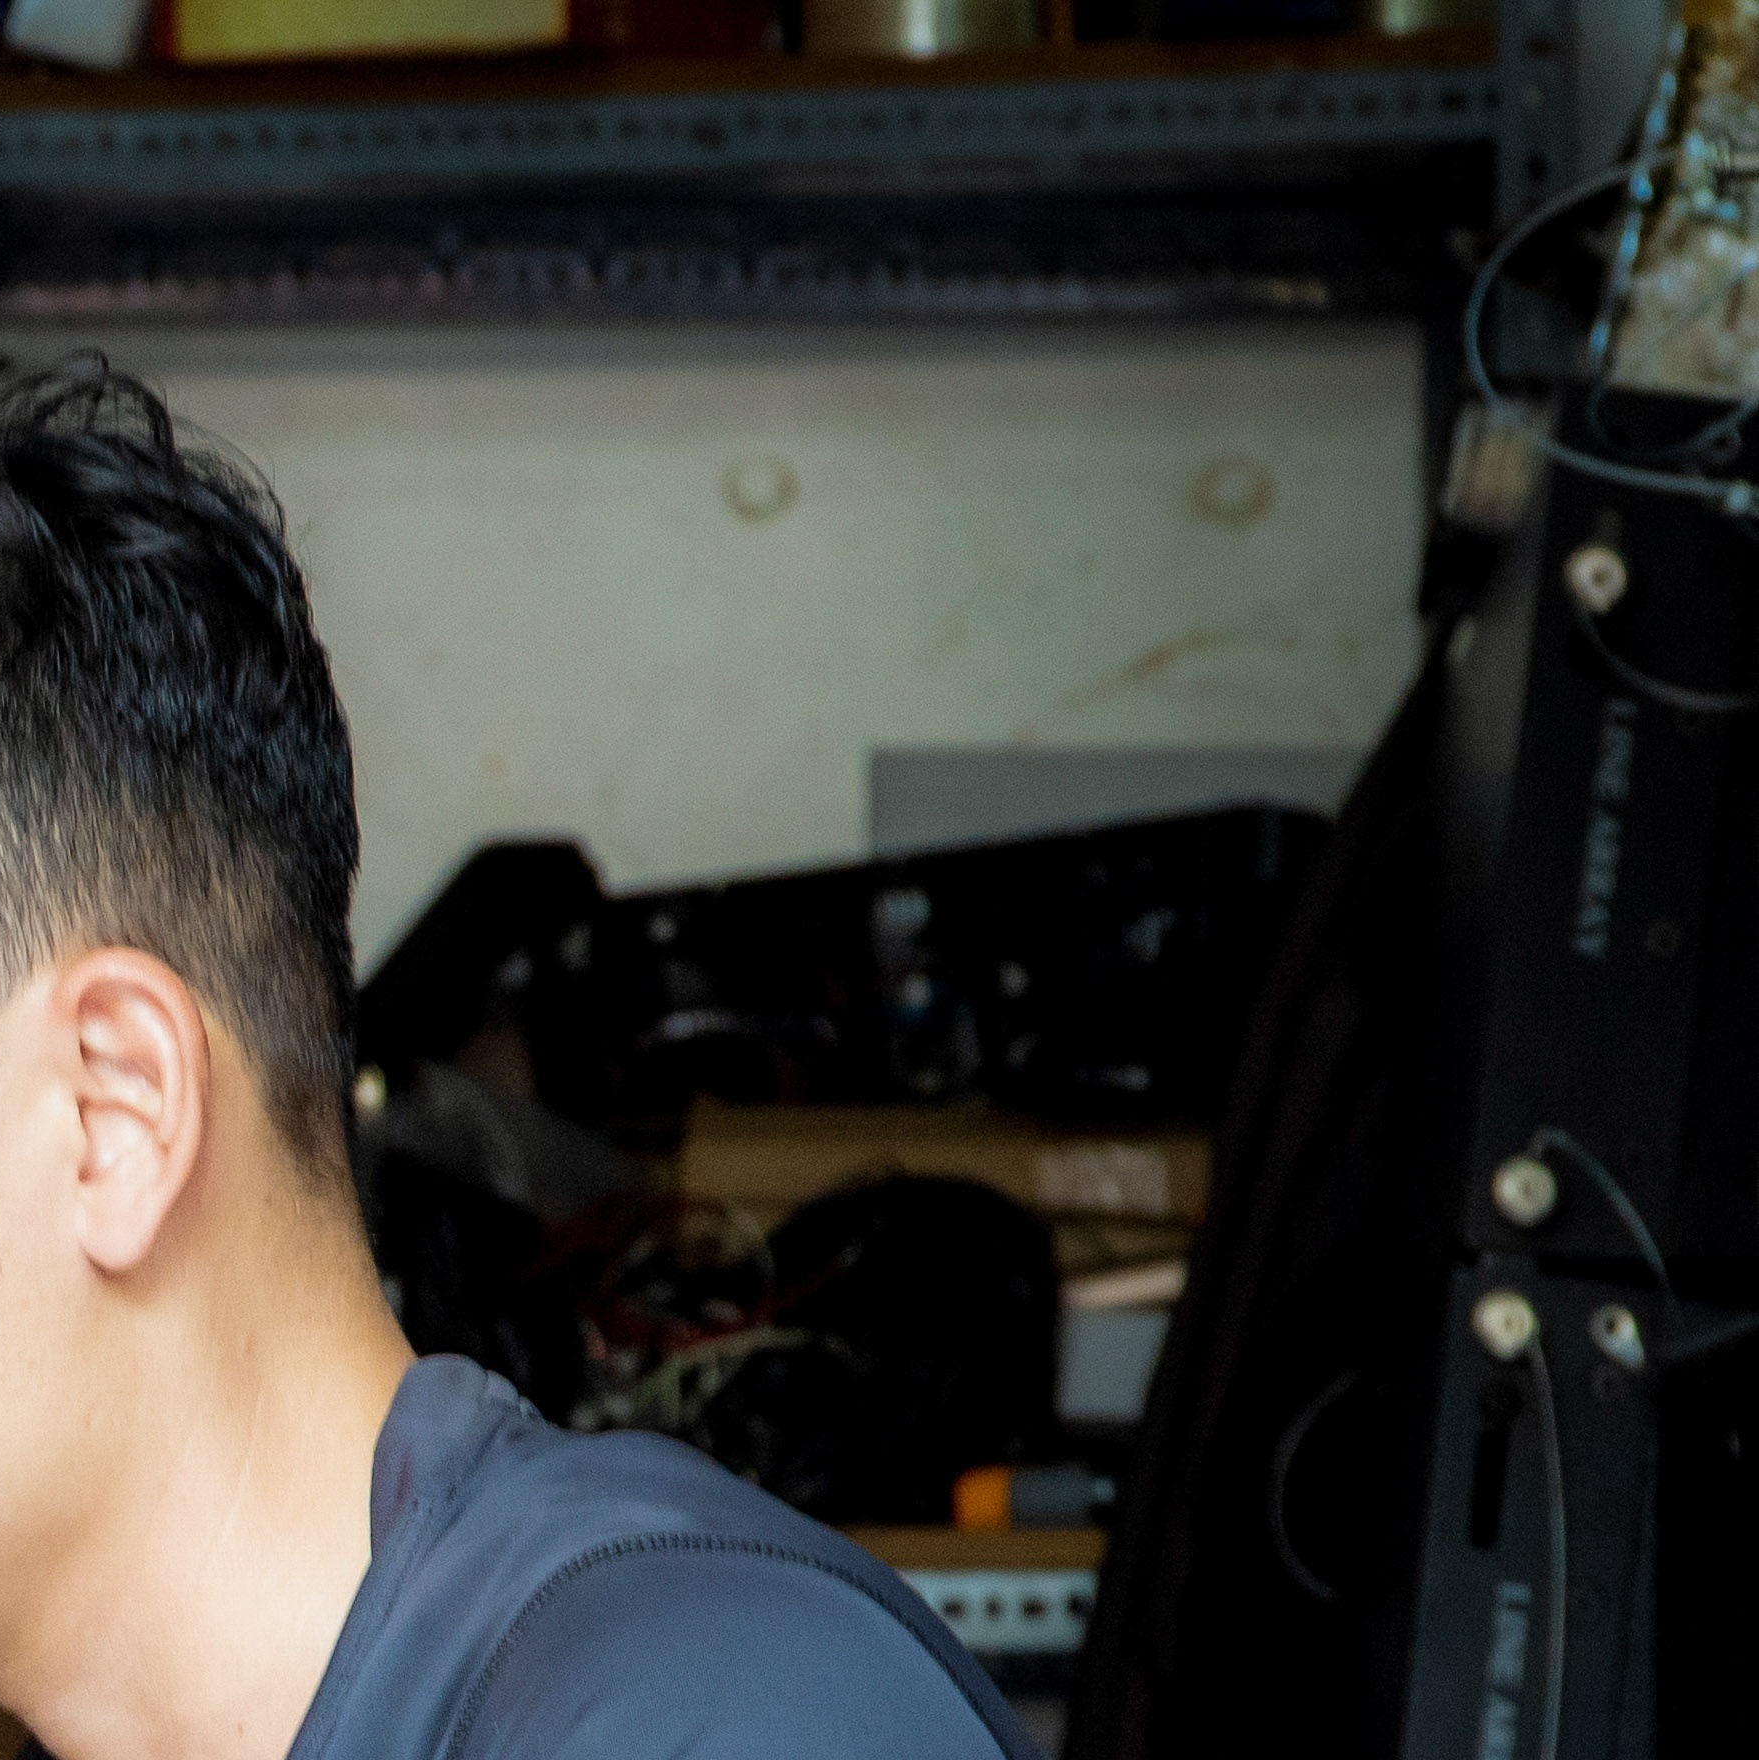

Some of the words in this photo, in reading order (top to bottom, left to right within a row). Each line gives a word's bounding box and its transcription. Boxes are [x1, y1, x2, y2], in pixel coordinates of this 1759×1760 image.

[1594, 699, 1636, 799] LINE
[1574, 810, 1619, 957] ARRAY
[1490, 1582, 1530, 1686] LINE
